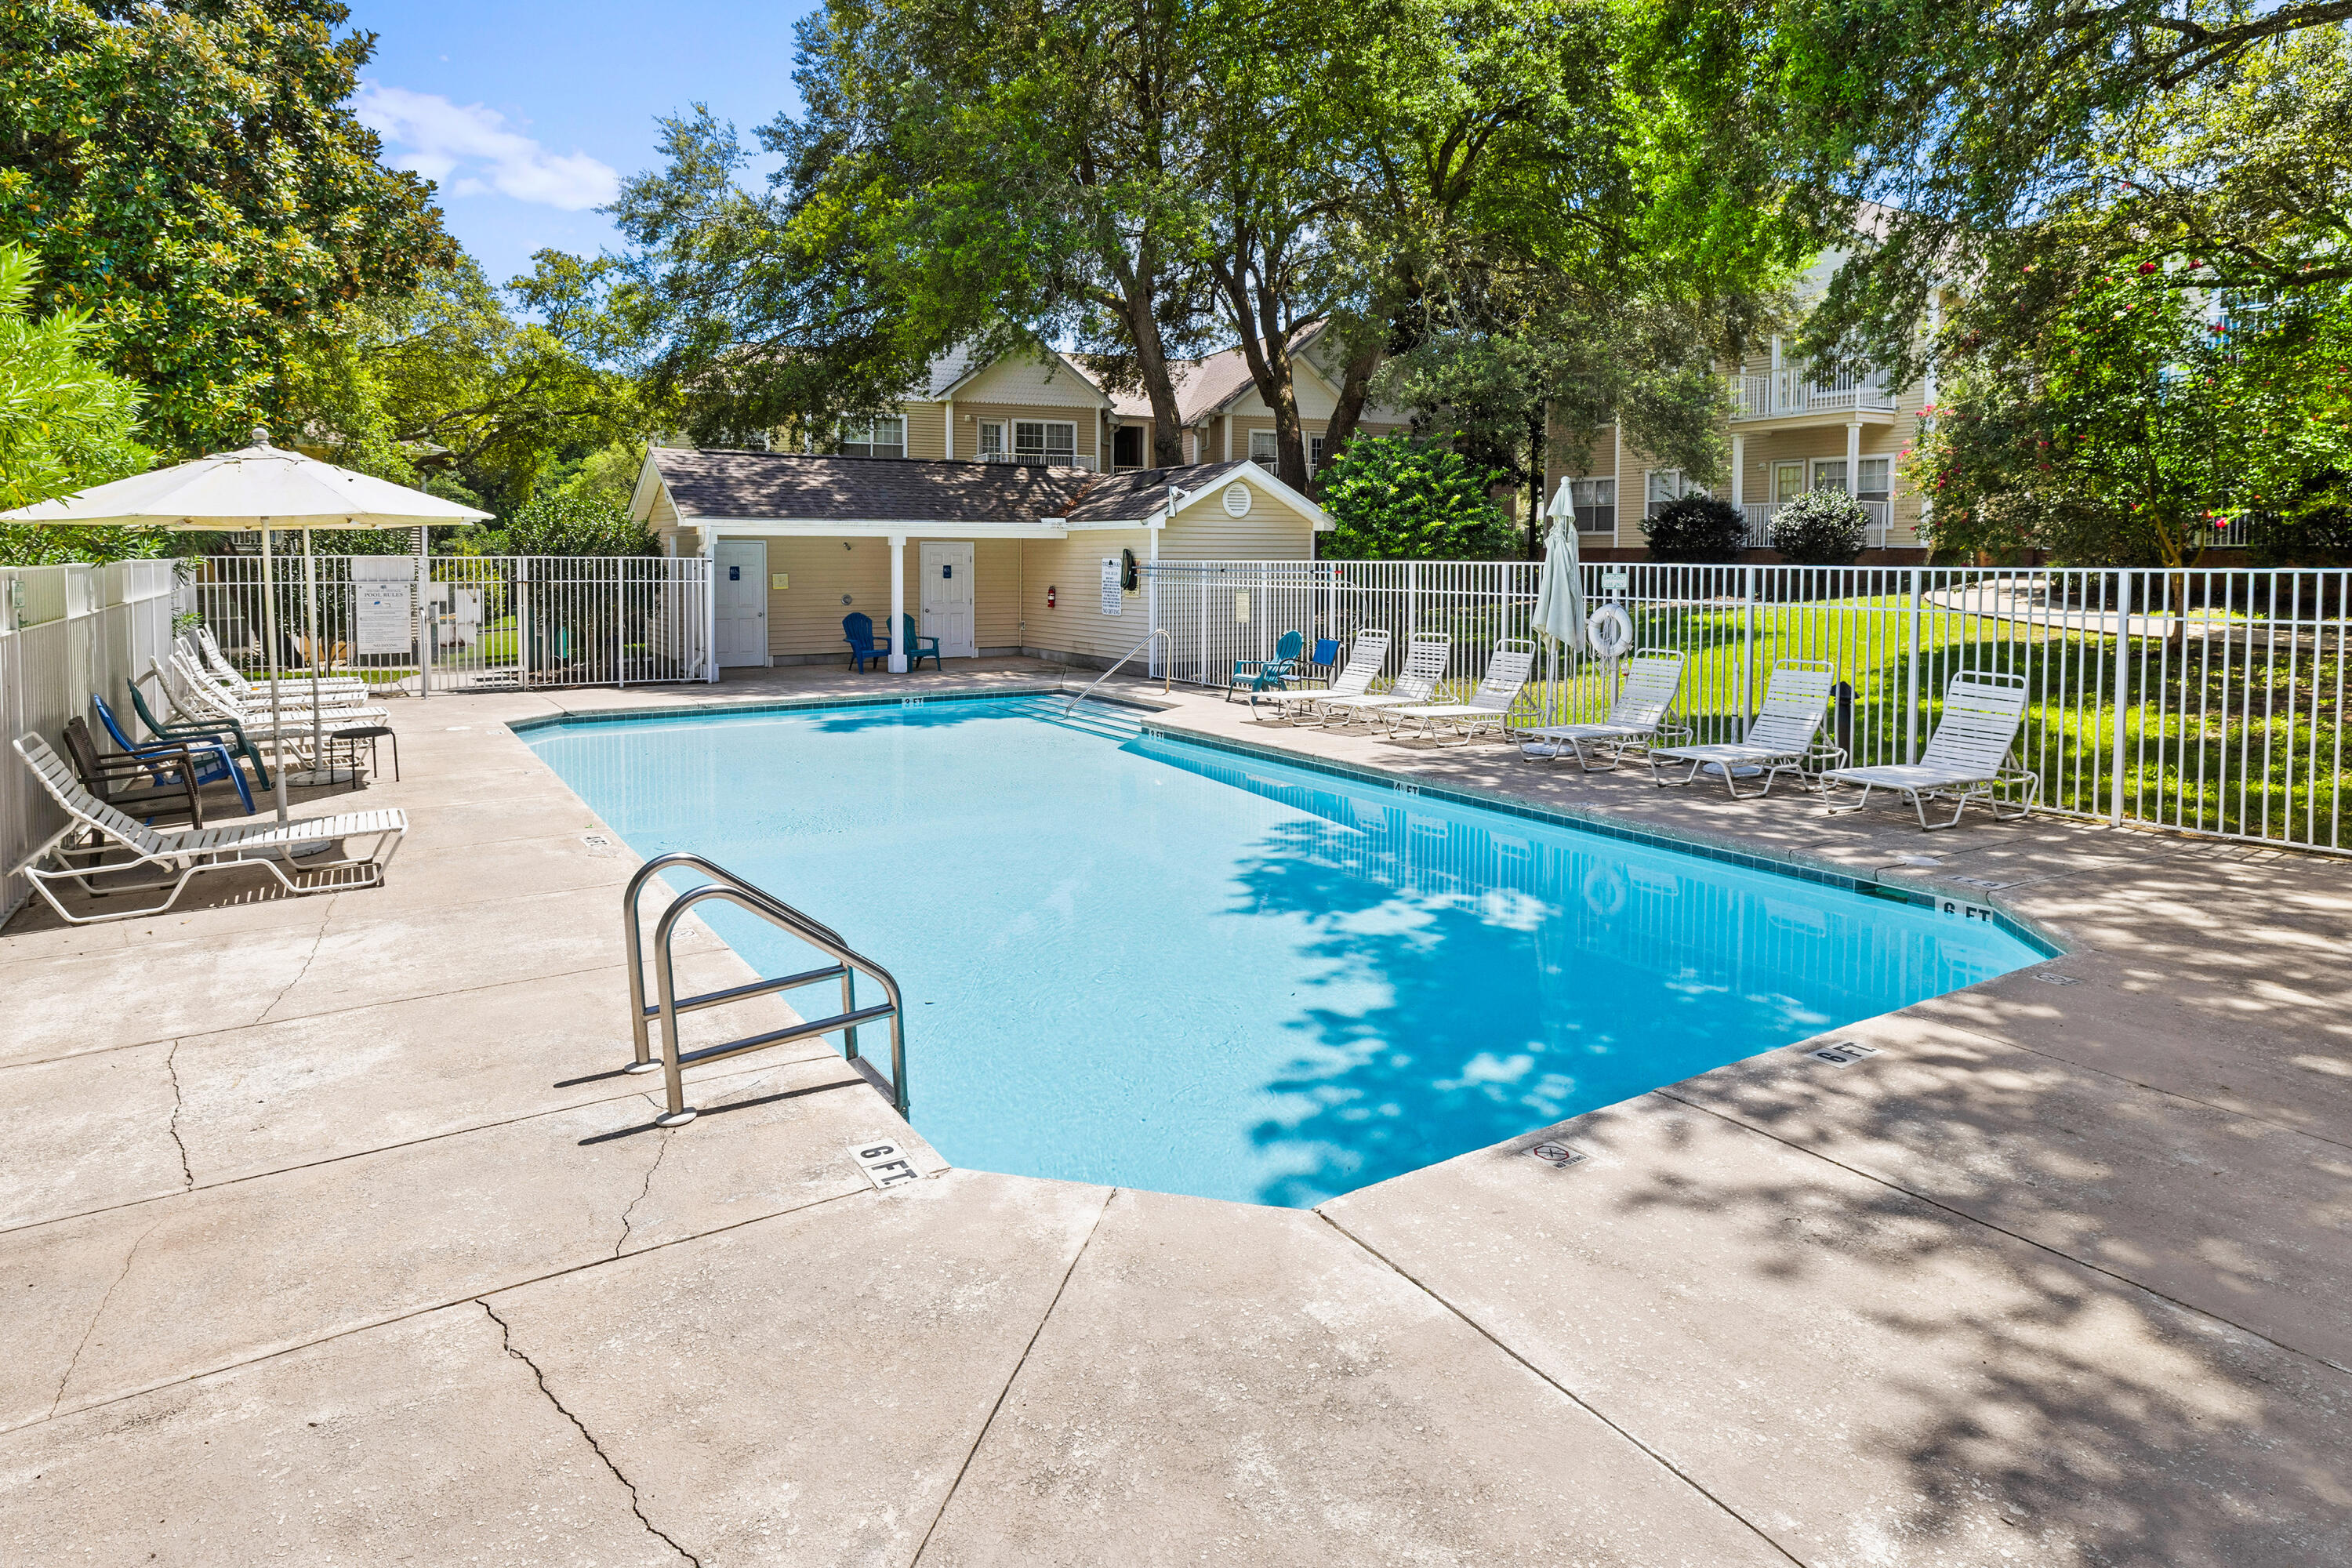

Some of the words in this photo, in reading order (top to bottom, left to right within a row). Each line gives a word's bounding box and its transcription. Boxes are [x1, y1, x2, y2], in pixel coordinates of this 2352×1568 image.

[1944, 902, 1955, 914] 6
[1965, 906, 1991, 922] FT
[1817, 1052, 1847, 1062] 6
[860, 1145, 895, 1158] 6
[871, 1160, 918, 1185] FT.
